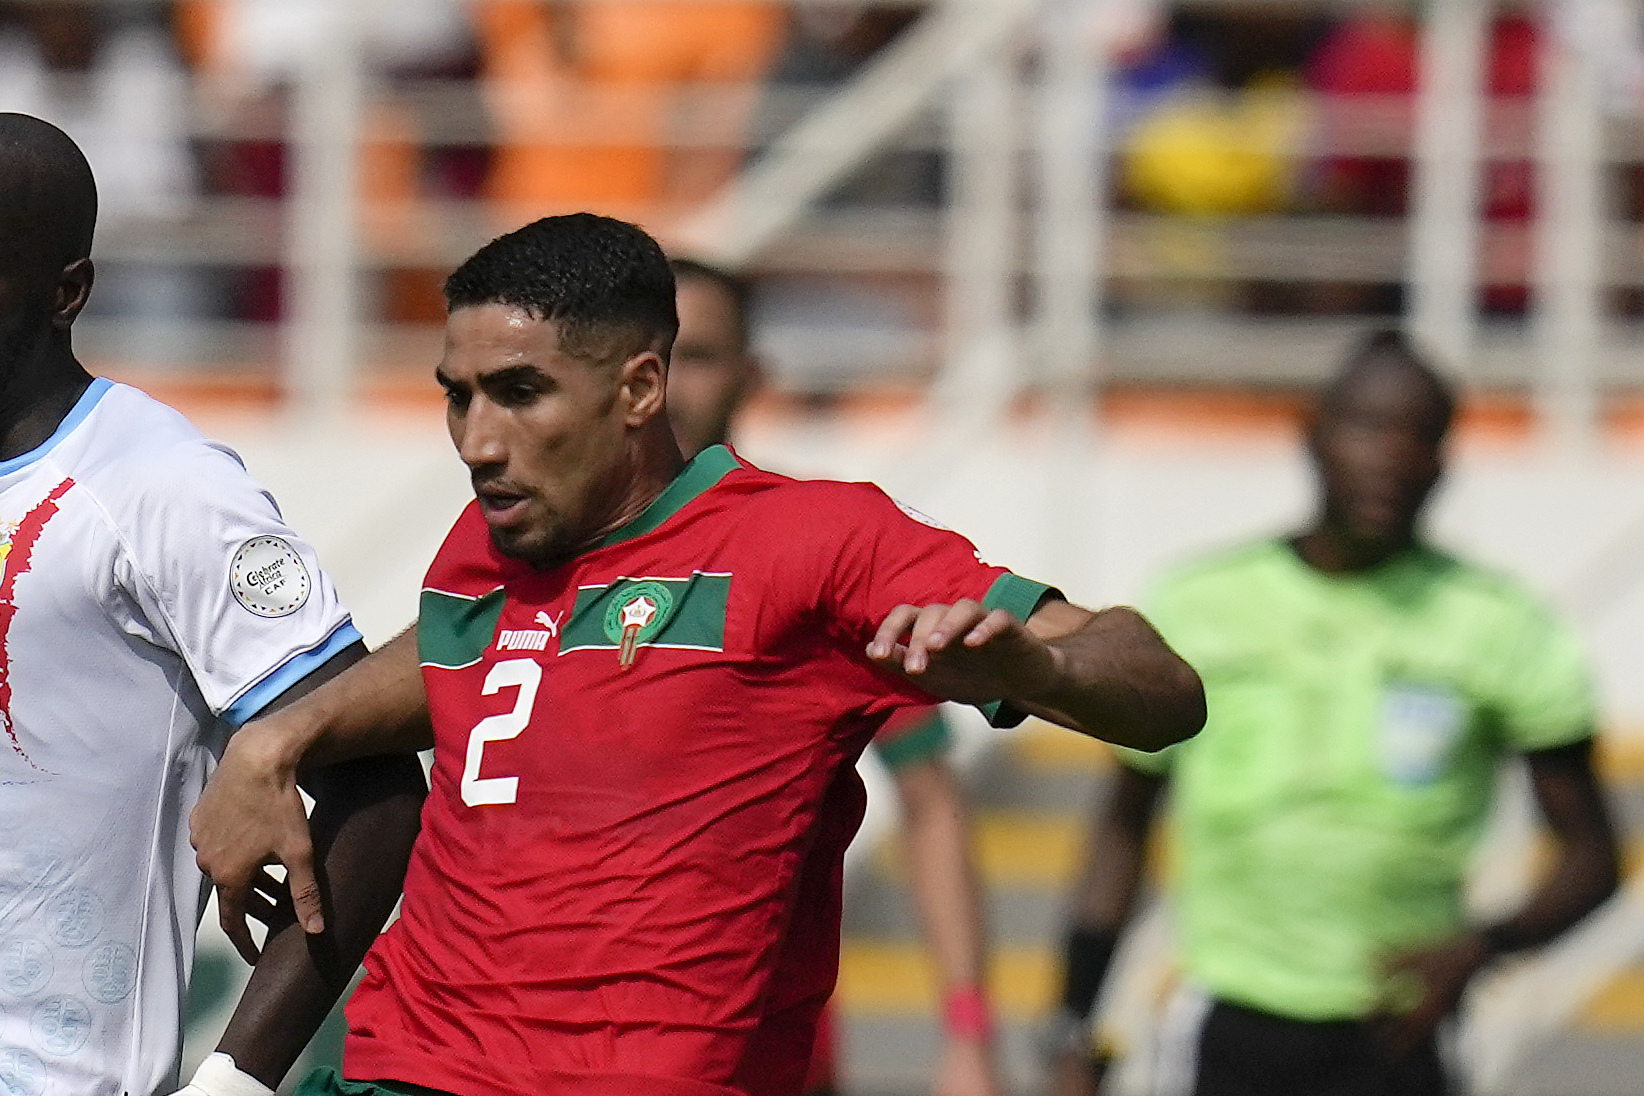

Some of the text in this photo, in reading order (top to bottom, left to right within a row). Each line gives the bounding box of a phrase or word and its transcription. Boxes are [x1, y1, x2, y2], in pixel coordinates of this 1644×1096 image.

[264, 579, 287, 596] CAF
[496, 629, 551, 651] PUMA
[460, 657, 543, 808] 2
